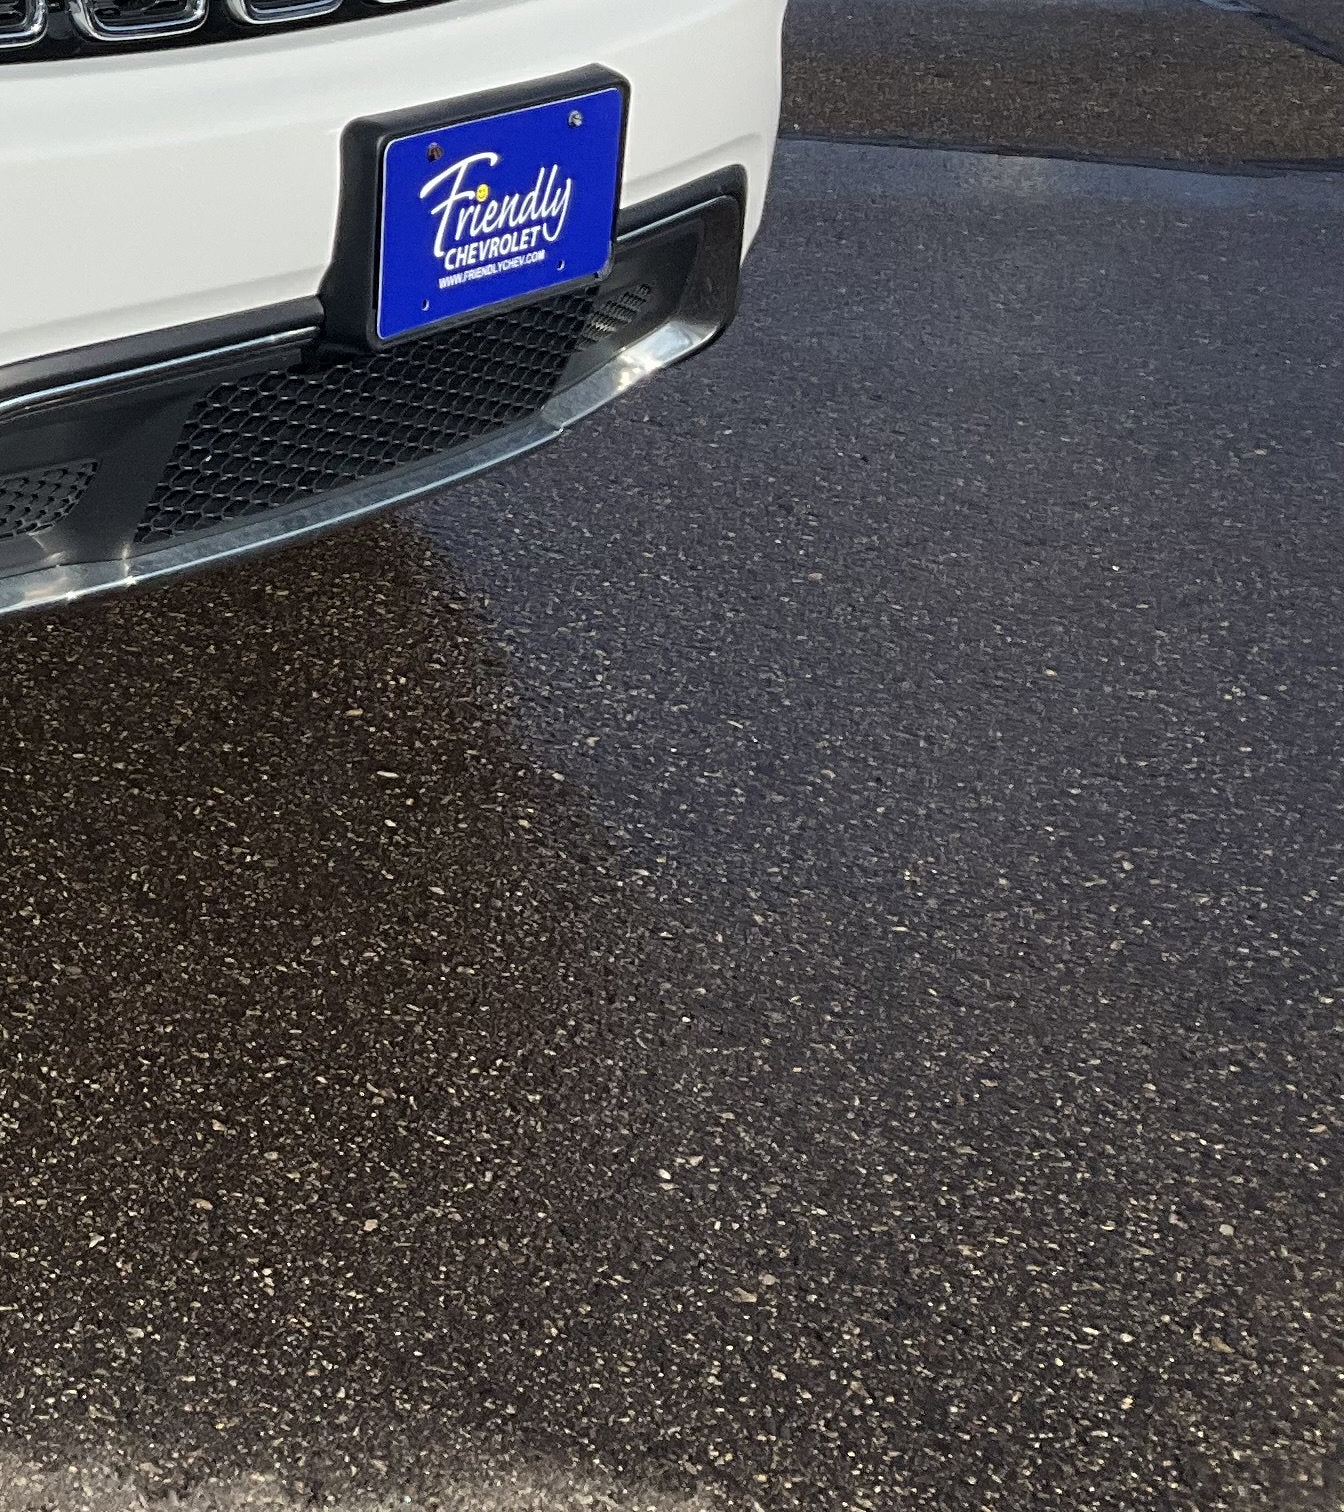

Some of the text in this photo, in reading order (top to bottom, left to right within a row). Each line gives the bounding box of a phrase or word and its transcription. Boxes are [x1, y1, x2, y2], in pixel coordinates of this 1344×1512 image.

[419, 152, 572, 257] Friendly
[438, 249, 545, 289] WWW.FRIENDLYCHEV.COM
[444, 225, 541, 270] CHEVROLET
